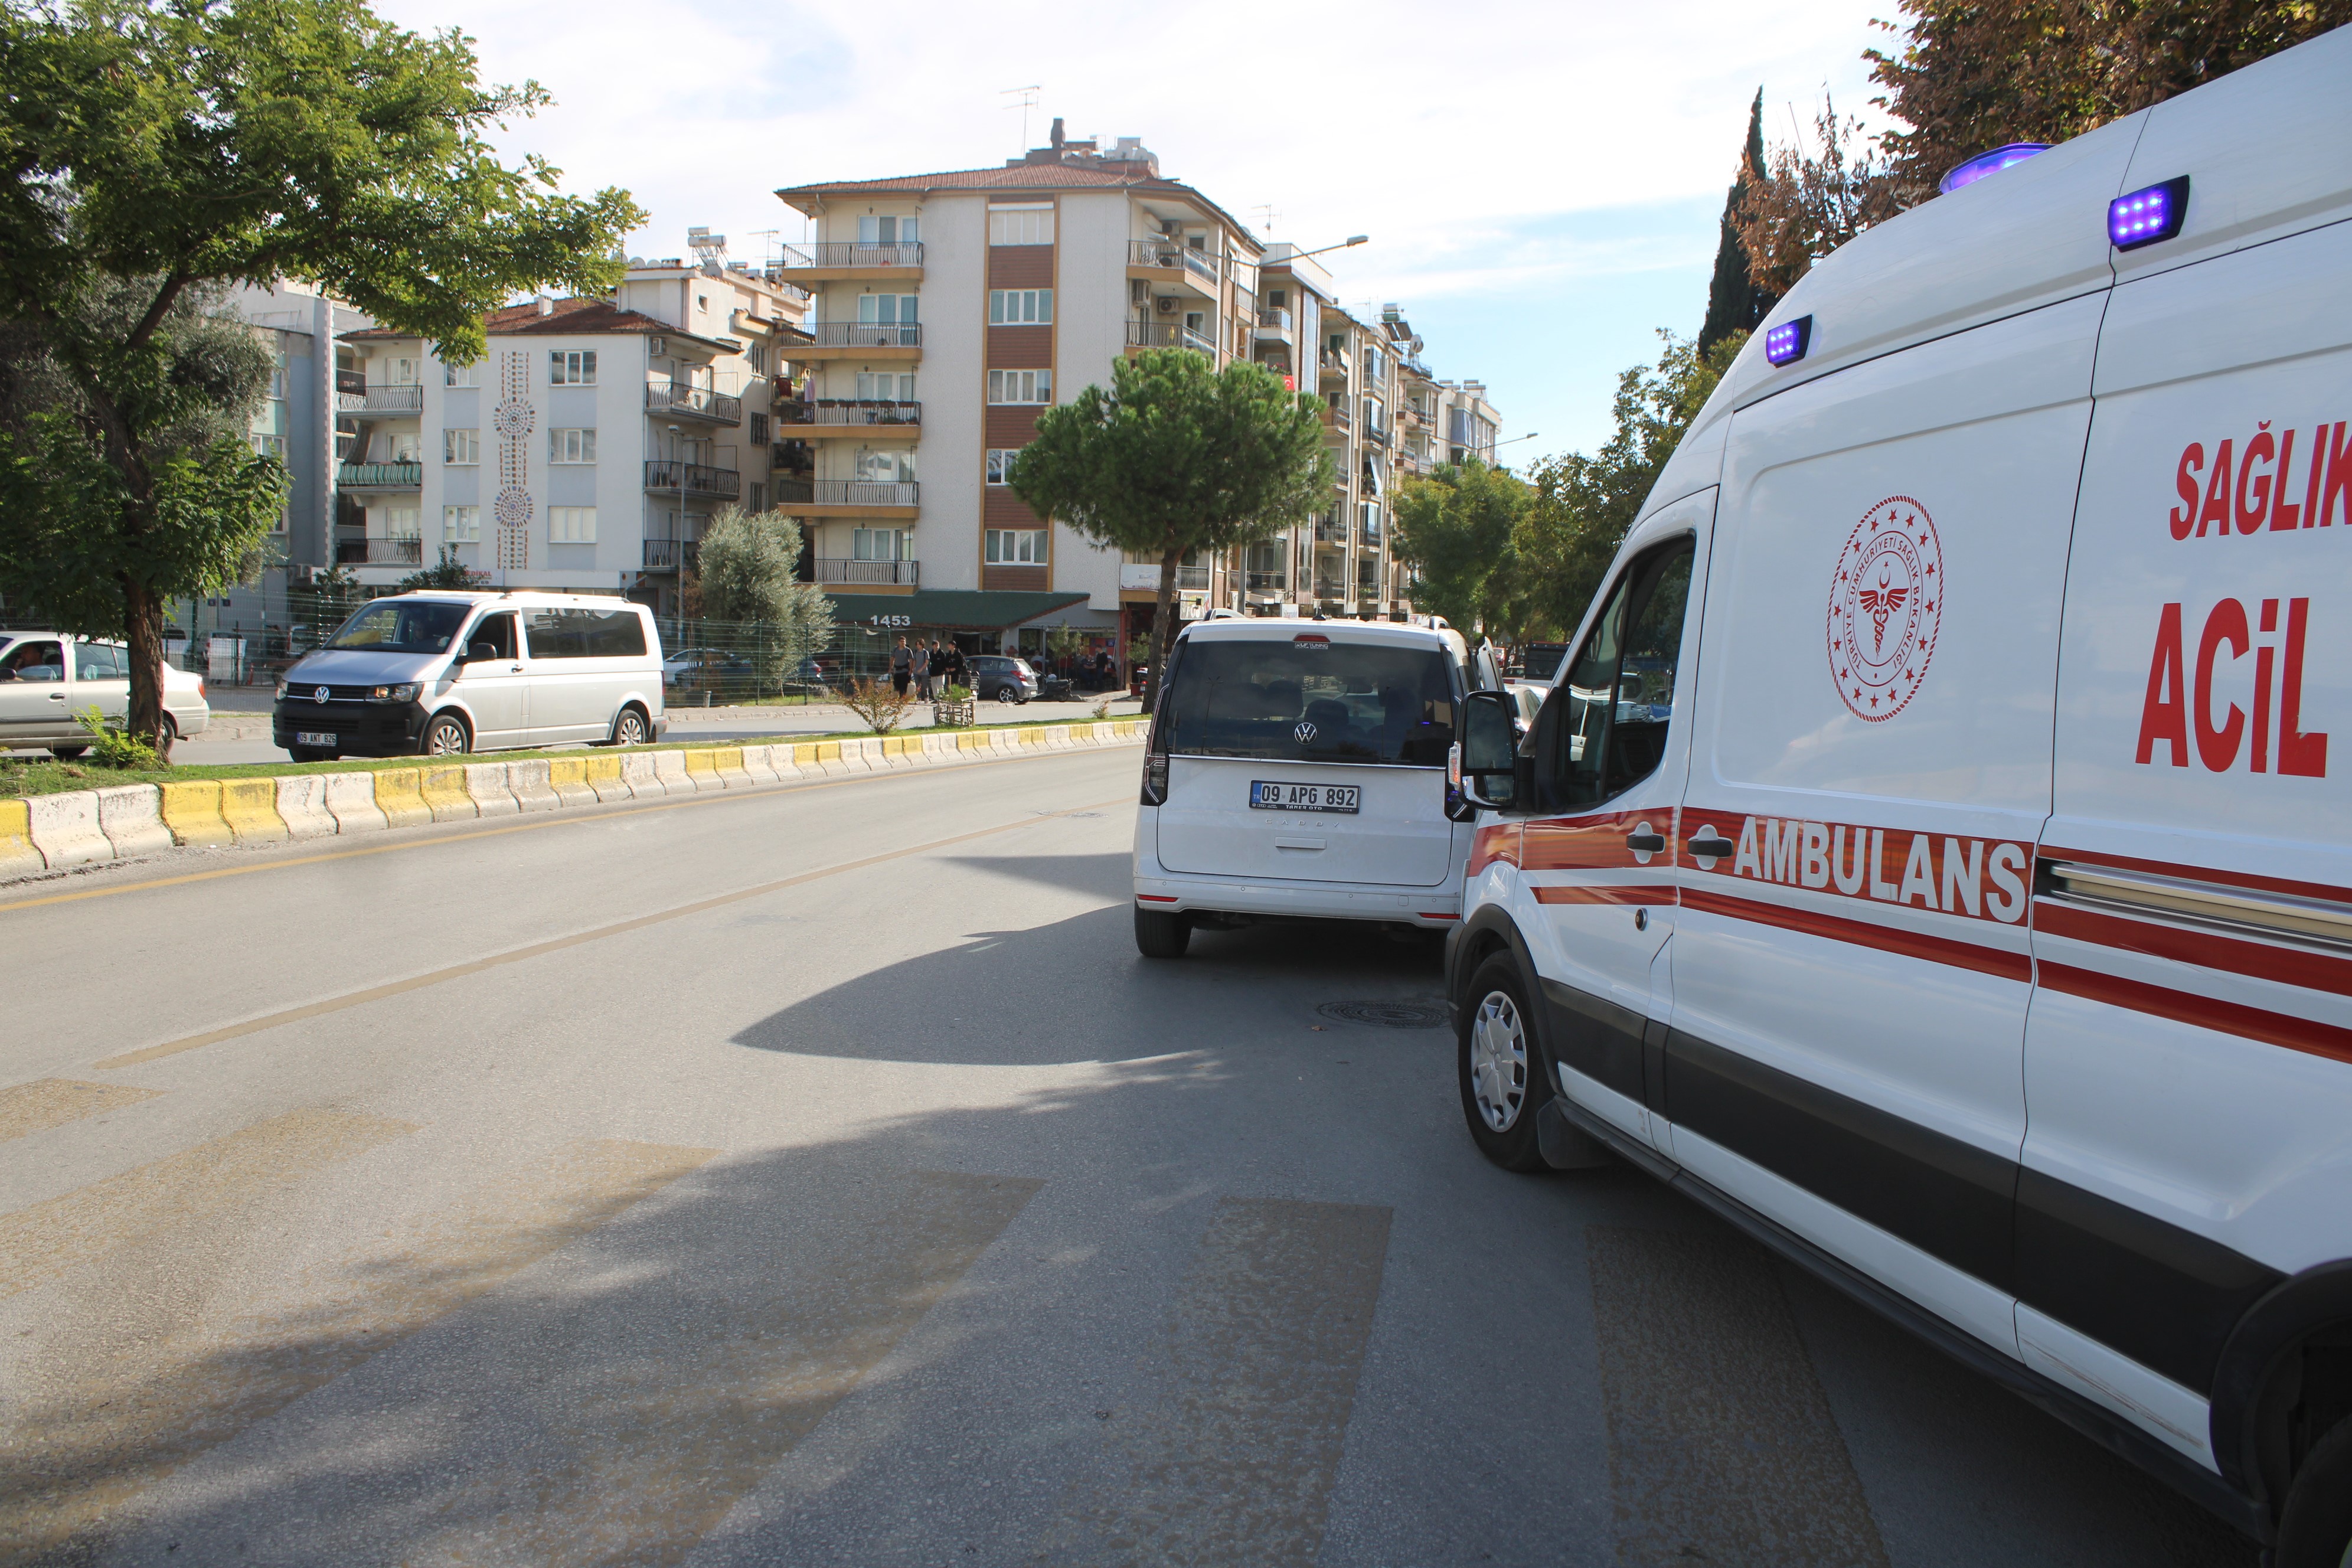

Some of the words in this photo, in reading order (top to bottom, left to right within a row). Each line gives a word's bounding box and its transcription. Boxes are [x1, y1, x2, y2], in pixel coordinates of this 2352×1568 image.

[2170, 420, 2352, 541] SAĞLIK
[1848, 535, 1897, 605] CUMHURİYETİ
[1897, 540, 1919, 582] SAĞLIK
[870, 615, 911, 626] 1453
[1845, 612, 1861, 670] TÜRKİYE
[1893, 586, 1919, 669] BAKANLIĞI
[300, 733, 307, 741] 09
[310, 734, 321, 742] ANT
[1262, 785, 1280, 802] 09
[1289, 786, 1318, 804] APG
[1326, 788, 1355, 806] 892
[1265, 818, 1340, 828] CADDY
[1733, 816, 2026, 923] AMBULANS
